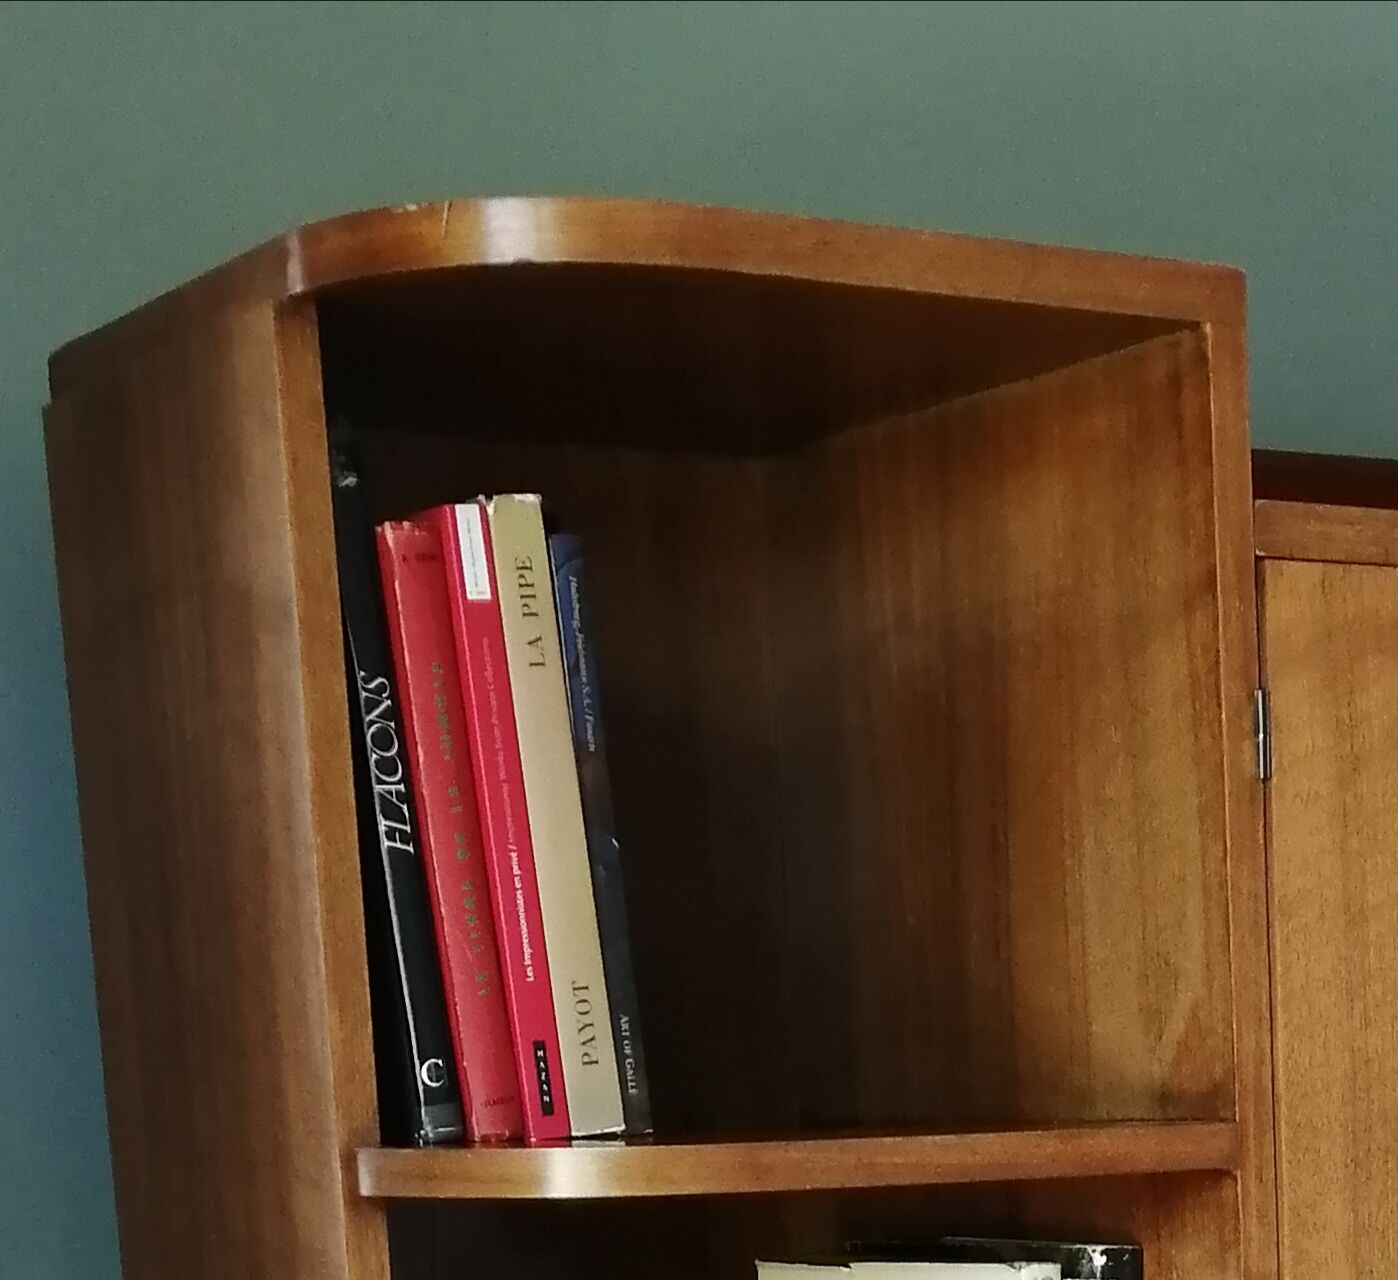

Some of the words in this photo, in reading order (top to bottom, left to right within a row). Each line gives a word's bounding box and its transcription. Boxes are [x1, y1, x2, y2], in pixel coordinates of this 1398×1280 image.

[515, 556, 539, 618] PIPE
[527, 633, 545, 667] LA
[359, 669, 415, 855] FLACONS
[508, 852, 521, 876] privé
[514, 876, 522, 889] en
[516, 890, 533, 965] Impressionnistes
[526, 965, 534, 982] Les
[572, 980, 599, 1068] PAYOT
[537, 1050, 550, 1104] HAZAN
